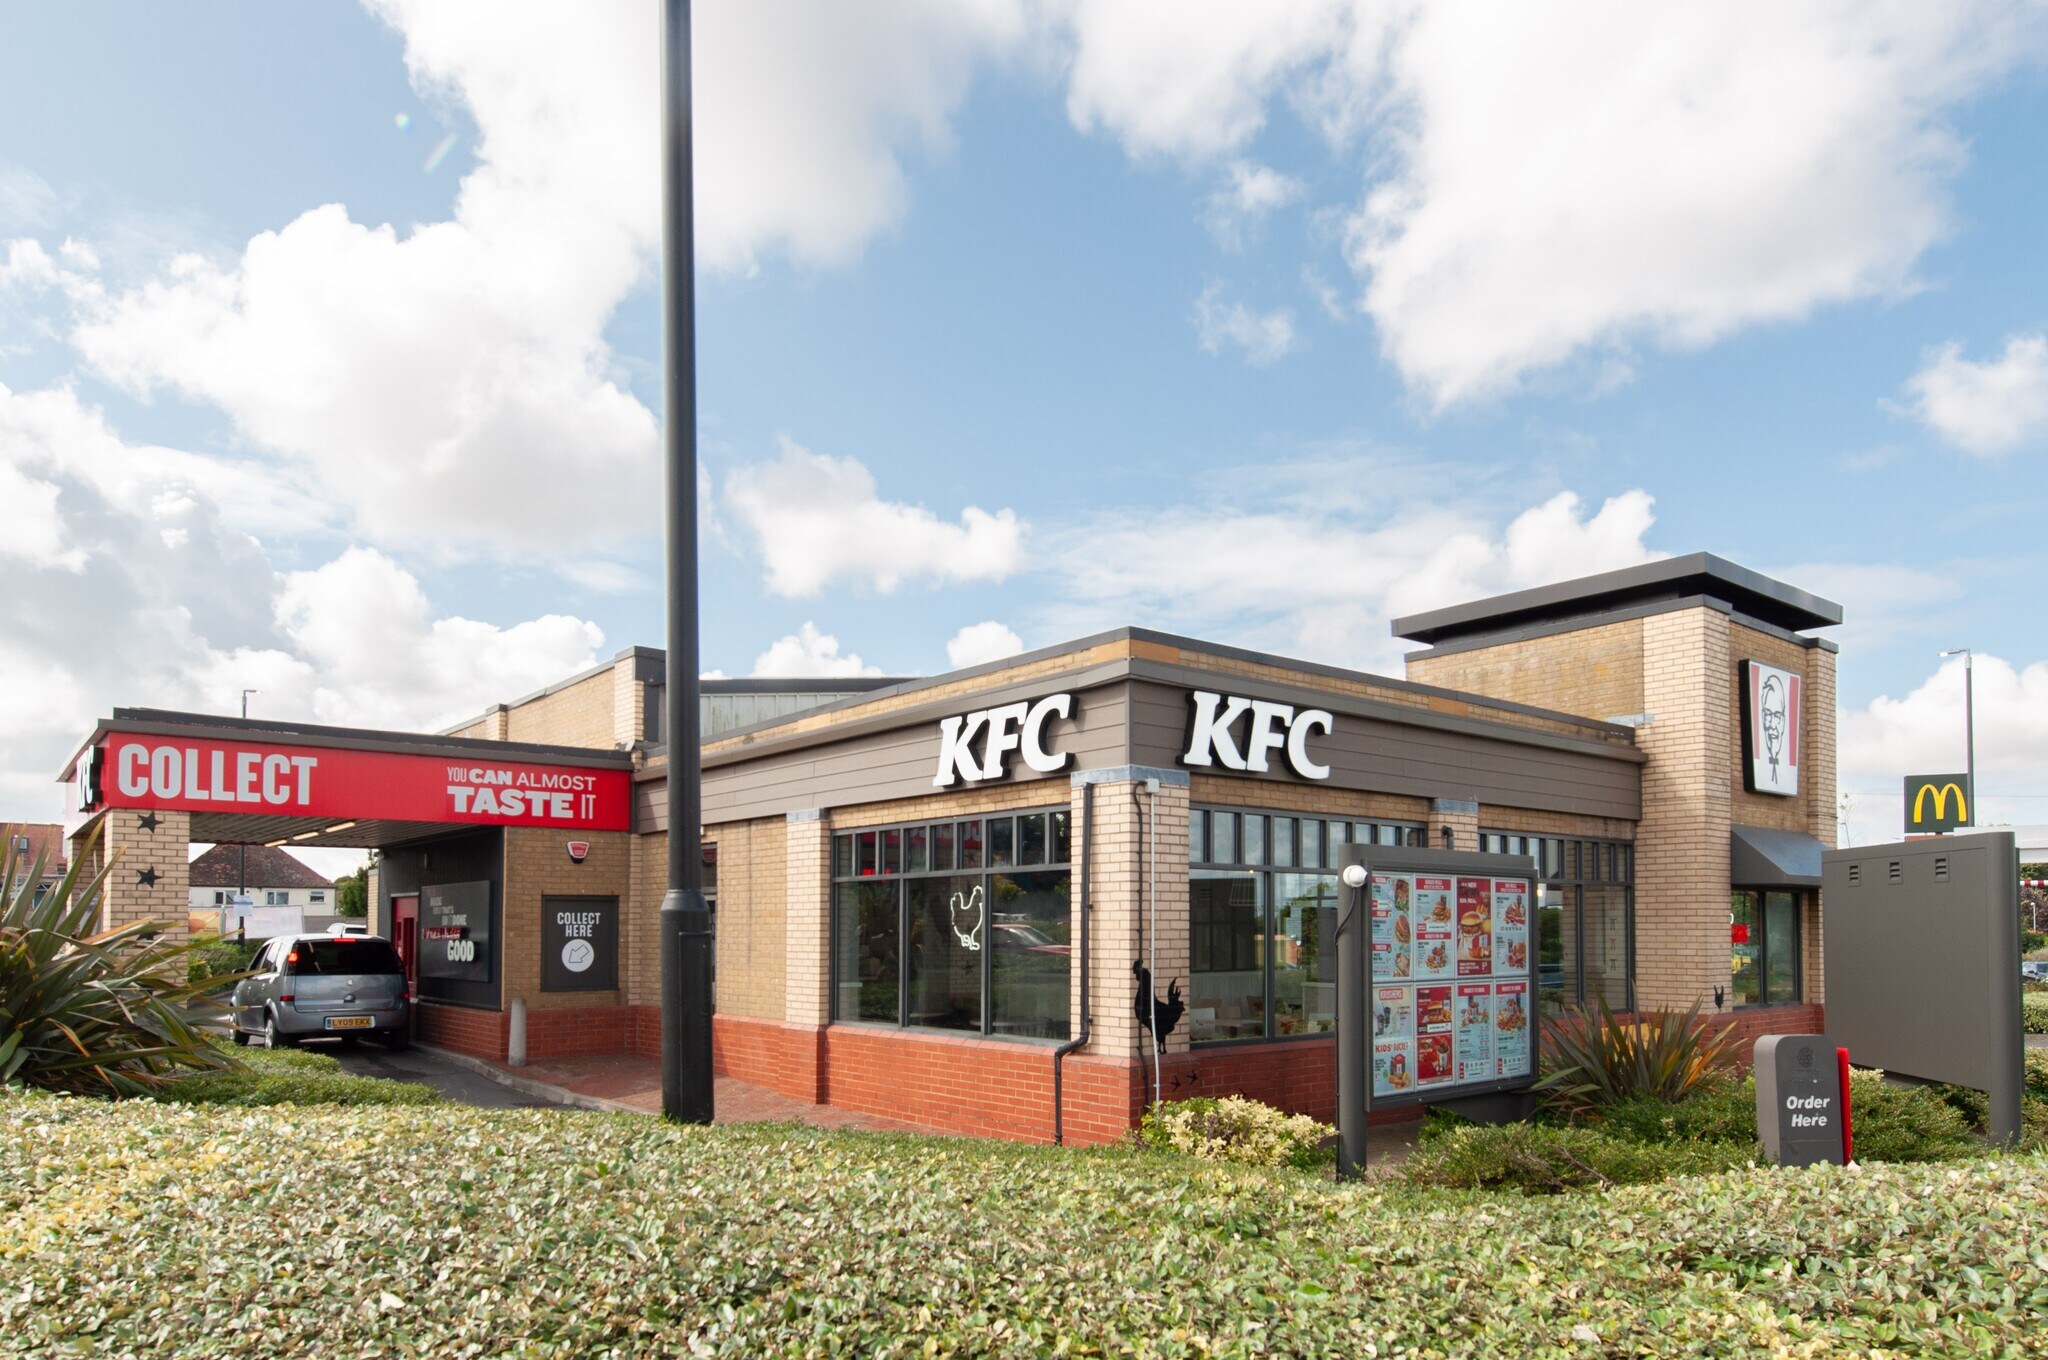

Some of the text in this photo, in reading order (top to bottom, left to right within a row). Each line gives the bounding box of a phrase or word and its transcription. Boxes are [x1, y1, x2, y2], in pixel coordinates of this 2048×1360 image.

[933, 693, 1071, 787] KFC
[1183, 690, 1334, 780] KFC
[118, 743, 318, 805] COLLECT
[447, 766, 597, 791] YOU CAN ALMOST
[447, 785, 597, 820] TASTE IT
[557, 912, 601, 925] COLLECT
[565, 925, 593, 937] HERE
[447, 940, 475, 962] GOOD
[1786, 1095, 1831, 1110] Order
[1791, 1113, 1828, 1128] Here
